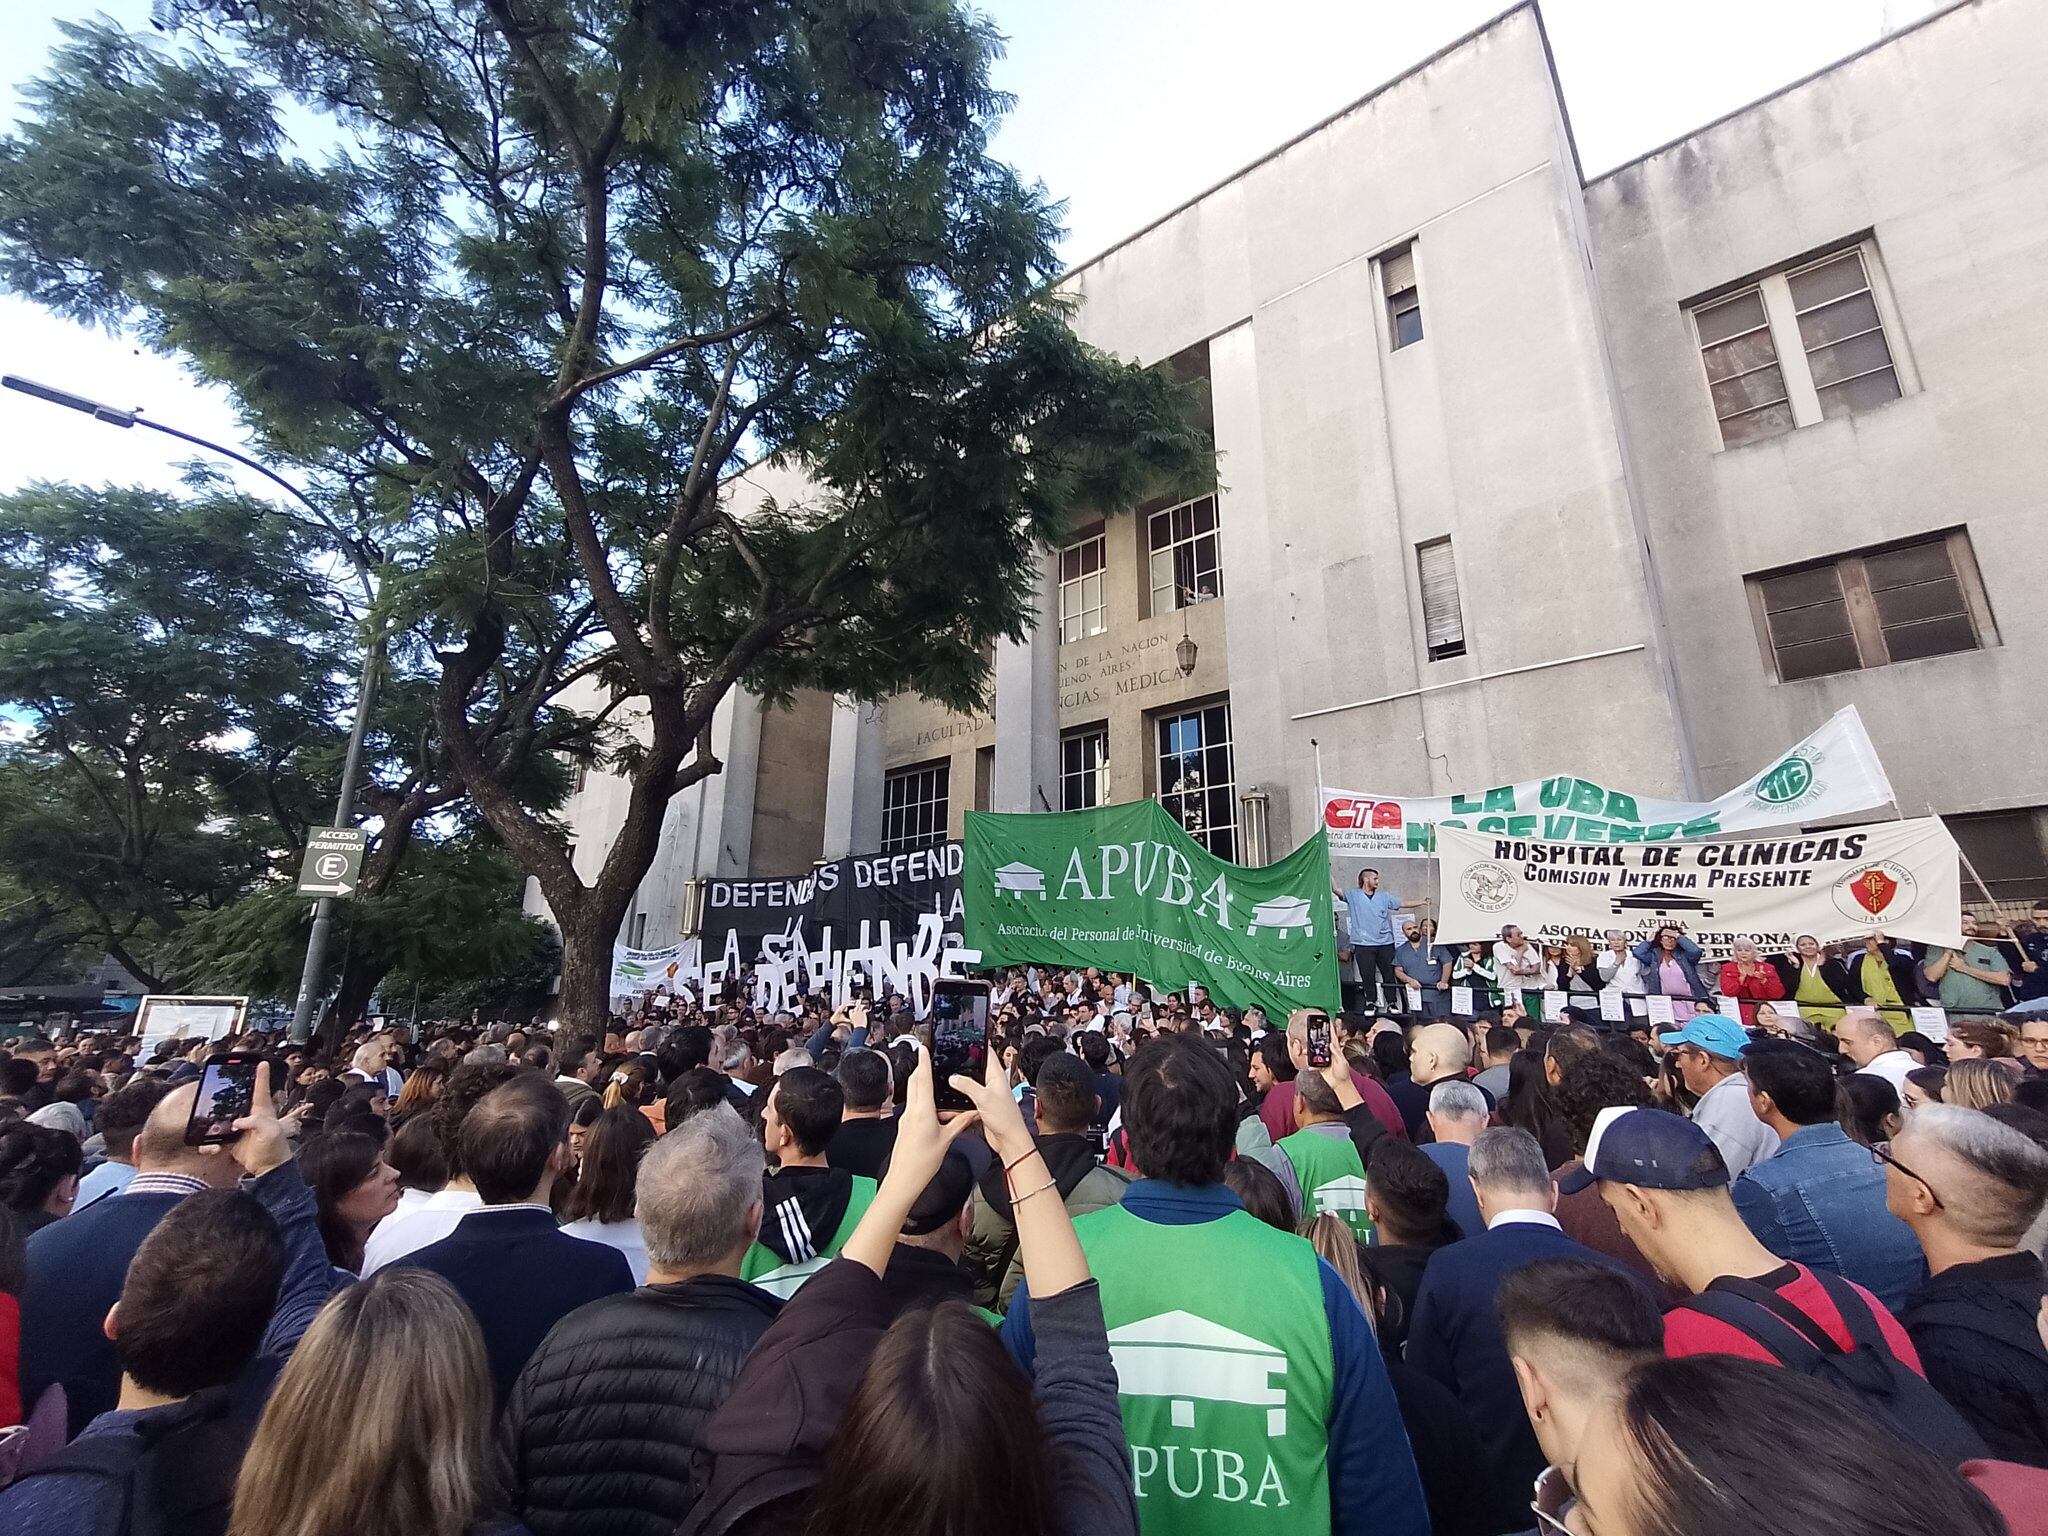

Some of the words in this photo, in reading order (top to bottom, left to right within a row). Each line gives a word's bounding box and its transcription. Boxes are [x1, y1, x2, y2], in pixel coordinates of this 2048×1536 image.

[1076, 656, 1090, 669] DE
[1099, 650, 1113, 663] LA
[1122, 633, 1169, 654] NACION
[1059, 673, 1092, 688] UENOS
[1100, 662, 1131, 678] AIRES
[1059, 687, 1100, 709] NCIAS
[1115, 666, 1182, 696] MEDICA
[917, 718, 984, 745] FACULTAD
[1324, 799, 1402, 829] CTA
[1451, 786, 1516, 814] LA
[1540, 777, 1641, 822] UBA
[307, 841, 364, 851] PERMITIDO
[318, 830, 359, 840] ACCESO
[1494, 840, 1626, 867] HOSPITAL
[1642, 847, 1682, 867] DE
[1697, 834, 1868, 868] CLINICAS
[321, 857, 342, 876] E
[1056, 840, 1234, 931] APUBA
[1538, 924, 1648, 943] ASOCIACON
[1638, 918, 1690, 931] APUBA
[1050, 926, 1068, 940] del
[1071, 926, 1120, 941] Personal
[1122, 926, 1136, 940] de
[1204, 949, 1223, 965] de
[1273, 970, 1312, 988] Aires
[1130, 1444, 1291, 1508] PUBA
